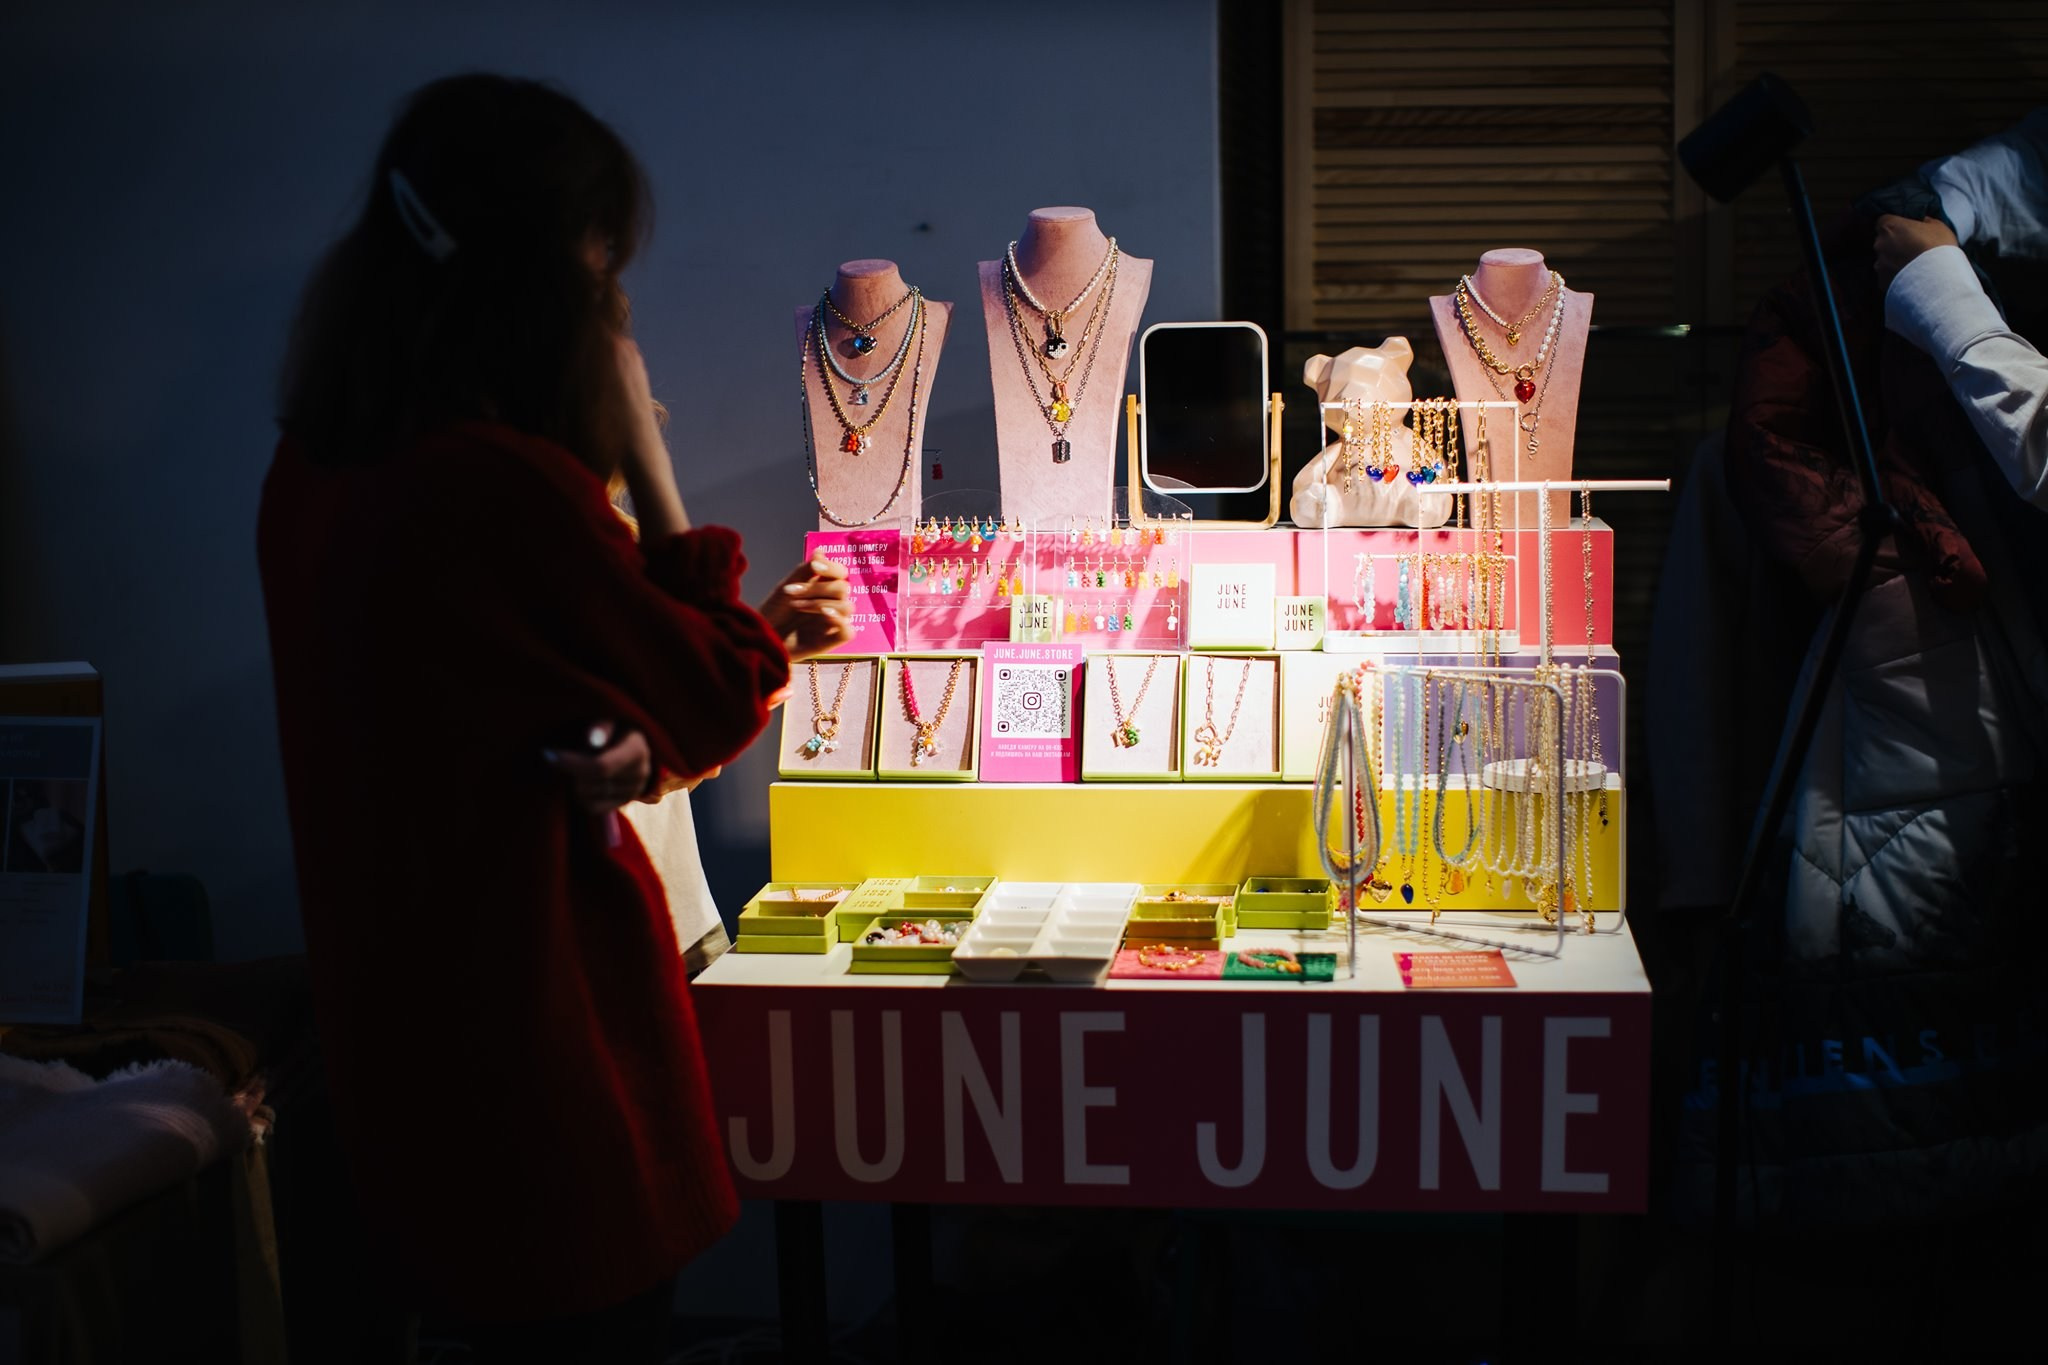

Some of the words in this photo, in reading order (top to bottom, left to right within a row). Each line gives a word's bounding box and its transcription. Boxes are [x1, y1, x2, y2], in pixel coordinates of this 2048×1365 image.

[847, 544, 857, 553] ПО
[858, 543, 888, 552] НОМЕРУ
[1217, 583, 1247, 595] JUNE
[1217, 597, 1247, 609] JUNE
[1284, 604, 1314, 616] JUNE
[1019, 616, 1048, 629] JUNE
[1284, 619, 1314, 631] JUNE
[993, 648, 1074, 660] JUNE.JUNE.STORE
[727, 1009, 1132, 1186] JUNE
[1195, 1011, 1612, 1195] JUNE
